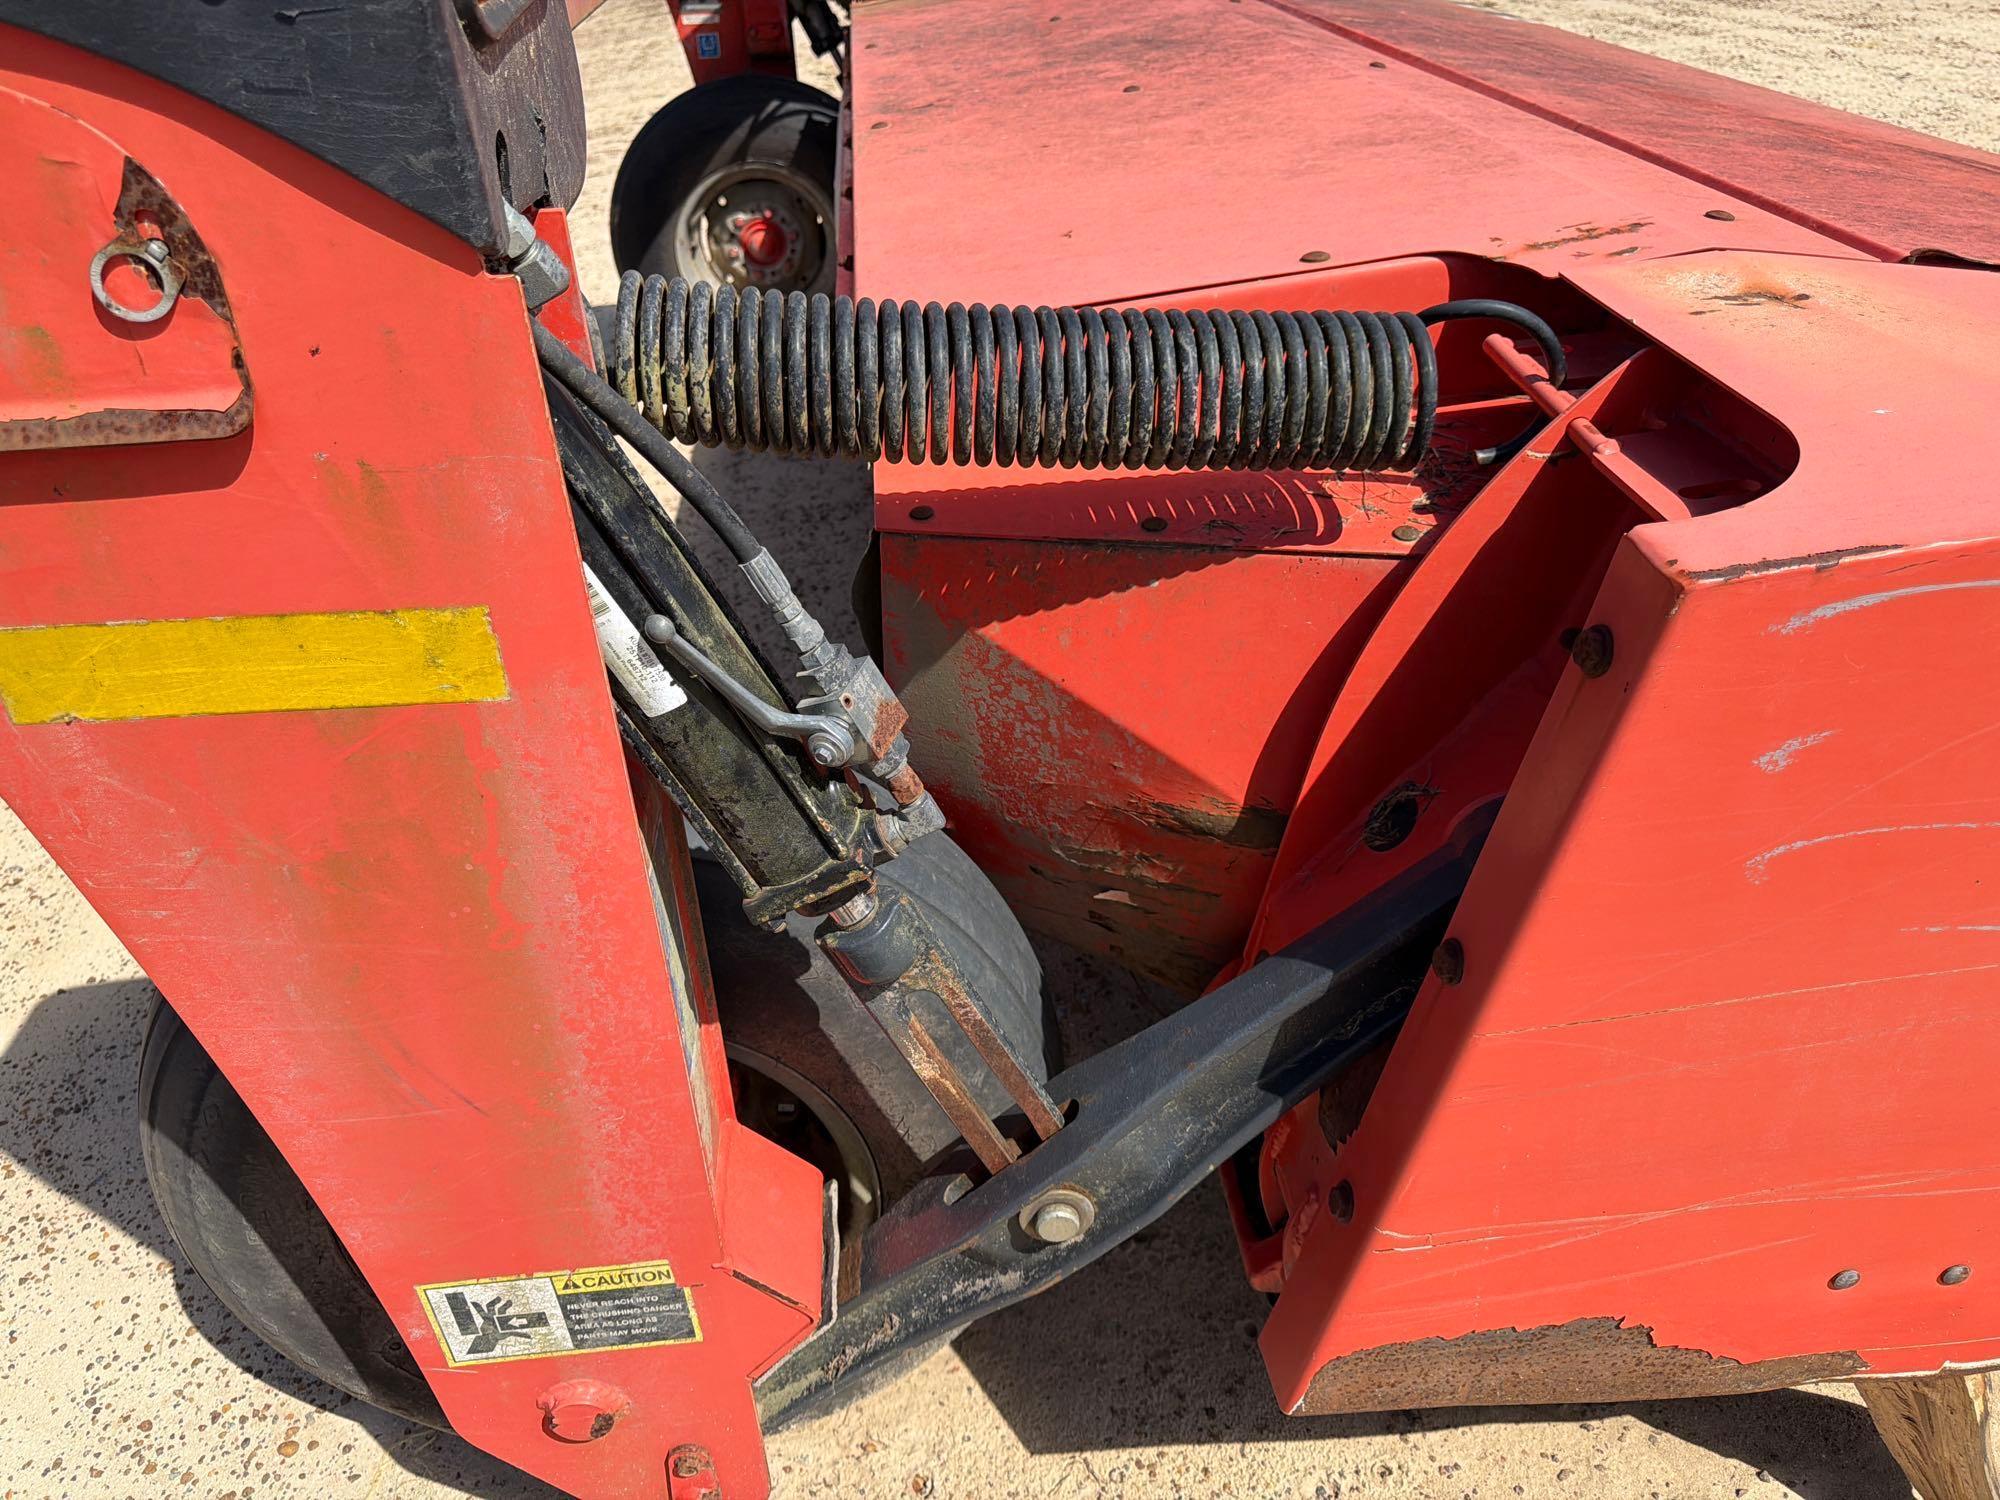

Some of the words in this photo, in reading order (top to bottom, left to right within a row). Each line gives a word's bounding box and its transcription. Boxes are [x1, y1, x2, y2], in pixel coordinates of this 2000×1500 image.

[629, 636, 645, 653] KUHN
[582, 1269, 671, 1288] CAUTION
[567, 1301, 598, 1310] NEVER
[601, 1298, 633, 1307] REACH
[591, 1308, 641, 1318] CRUSHING
[643, 1304, 682, 1312] DANGER
[574, 1322, 599, 1330] AREA
[577, 1332, 607, 1340] PARTS
